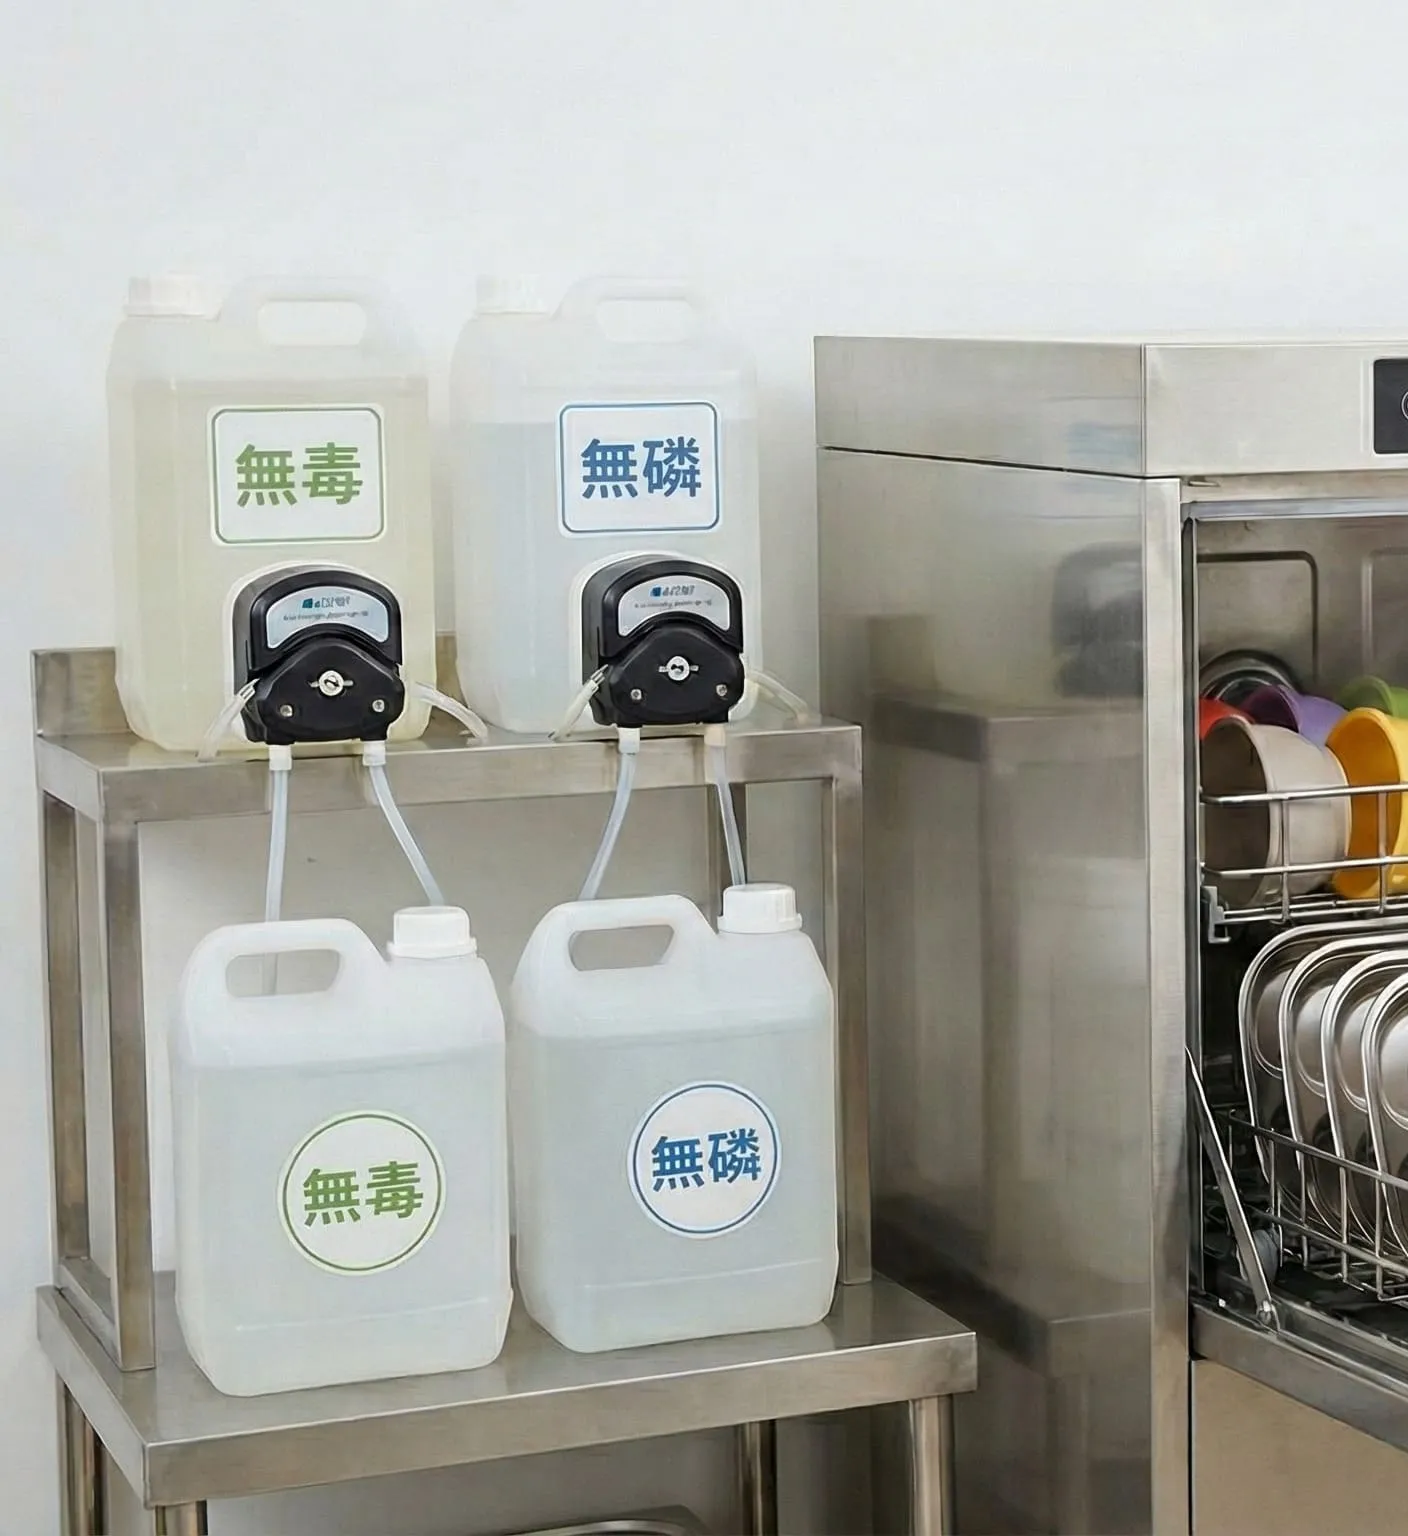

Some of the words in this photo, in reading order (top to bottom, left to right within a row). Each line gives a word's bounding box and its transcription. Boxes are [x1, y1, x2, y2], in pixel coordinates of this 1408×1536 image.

[235, 442, 364, 508] 無毒
[580, 437, 703, 499] 無磷
[650, 1128, 762, 1192] 無磷
[303, 1160, 424, 1228] 無毒
